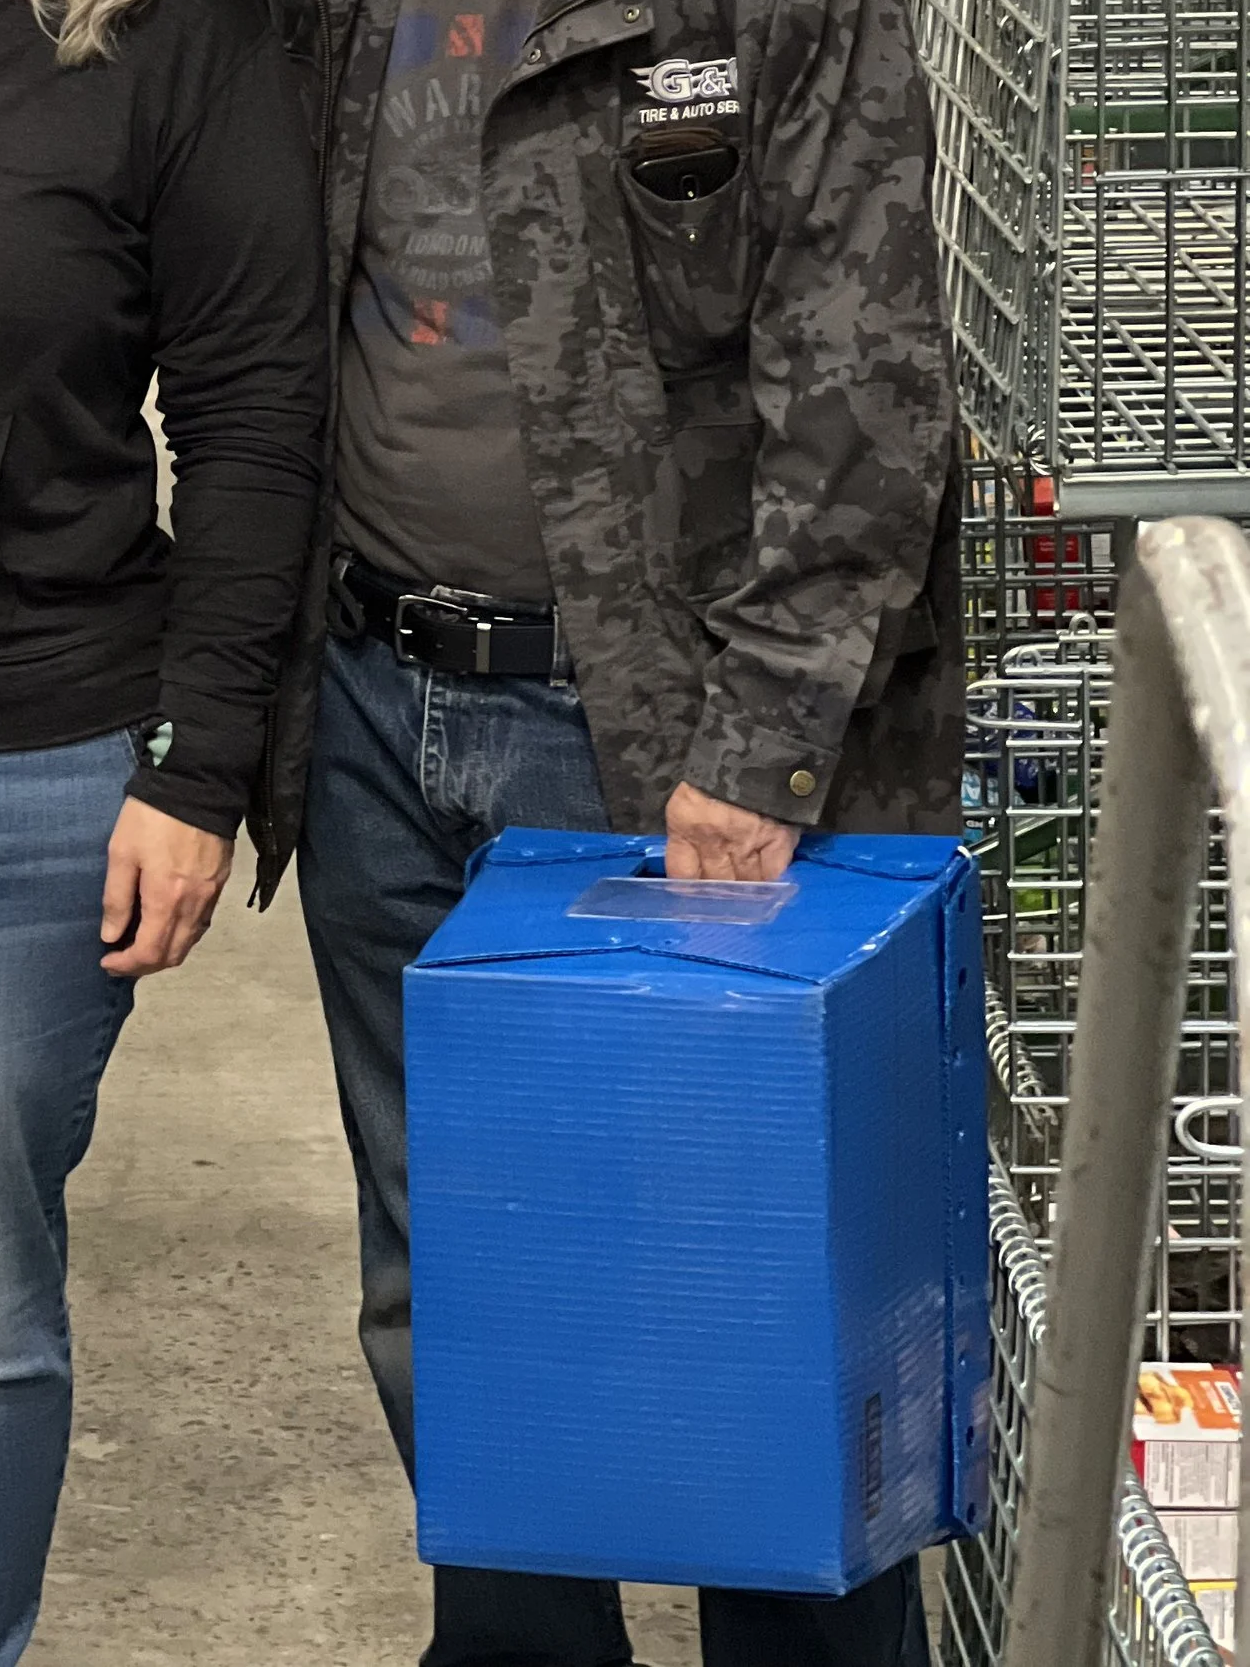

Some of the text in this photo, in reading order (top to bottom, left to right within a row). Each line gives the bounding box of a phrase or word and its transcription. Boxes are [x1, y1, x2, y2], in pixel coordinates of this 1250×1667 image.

[639, 107, 668, 124] TIRE
[669, 108, 680, 120] &
[681, 103, 715, 119] AUTO
